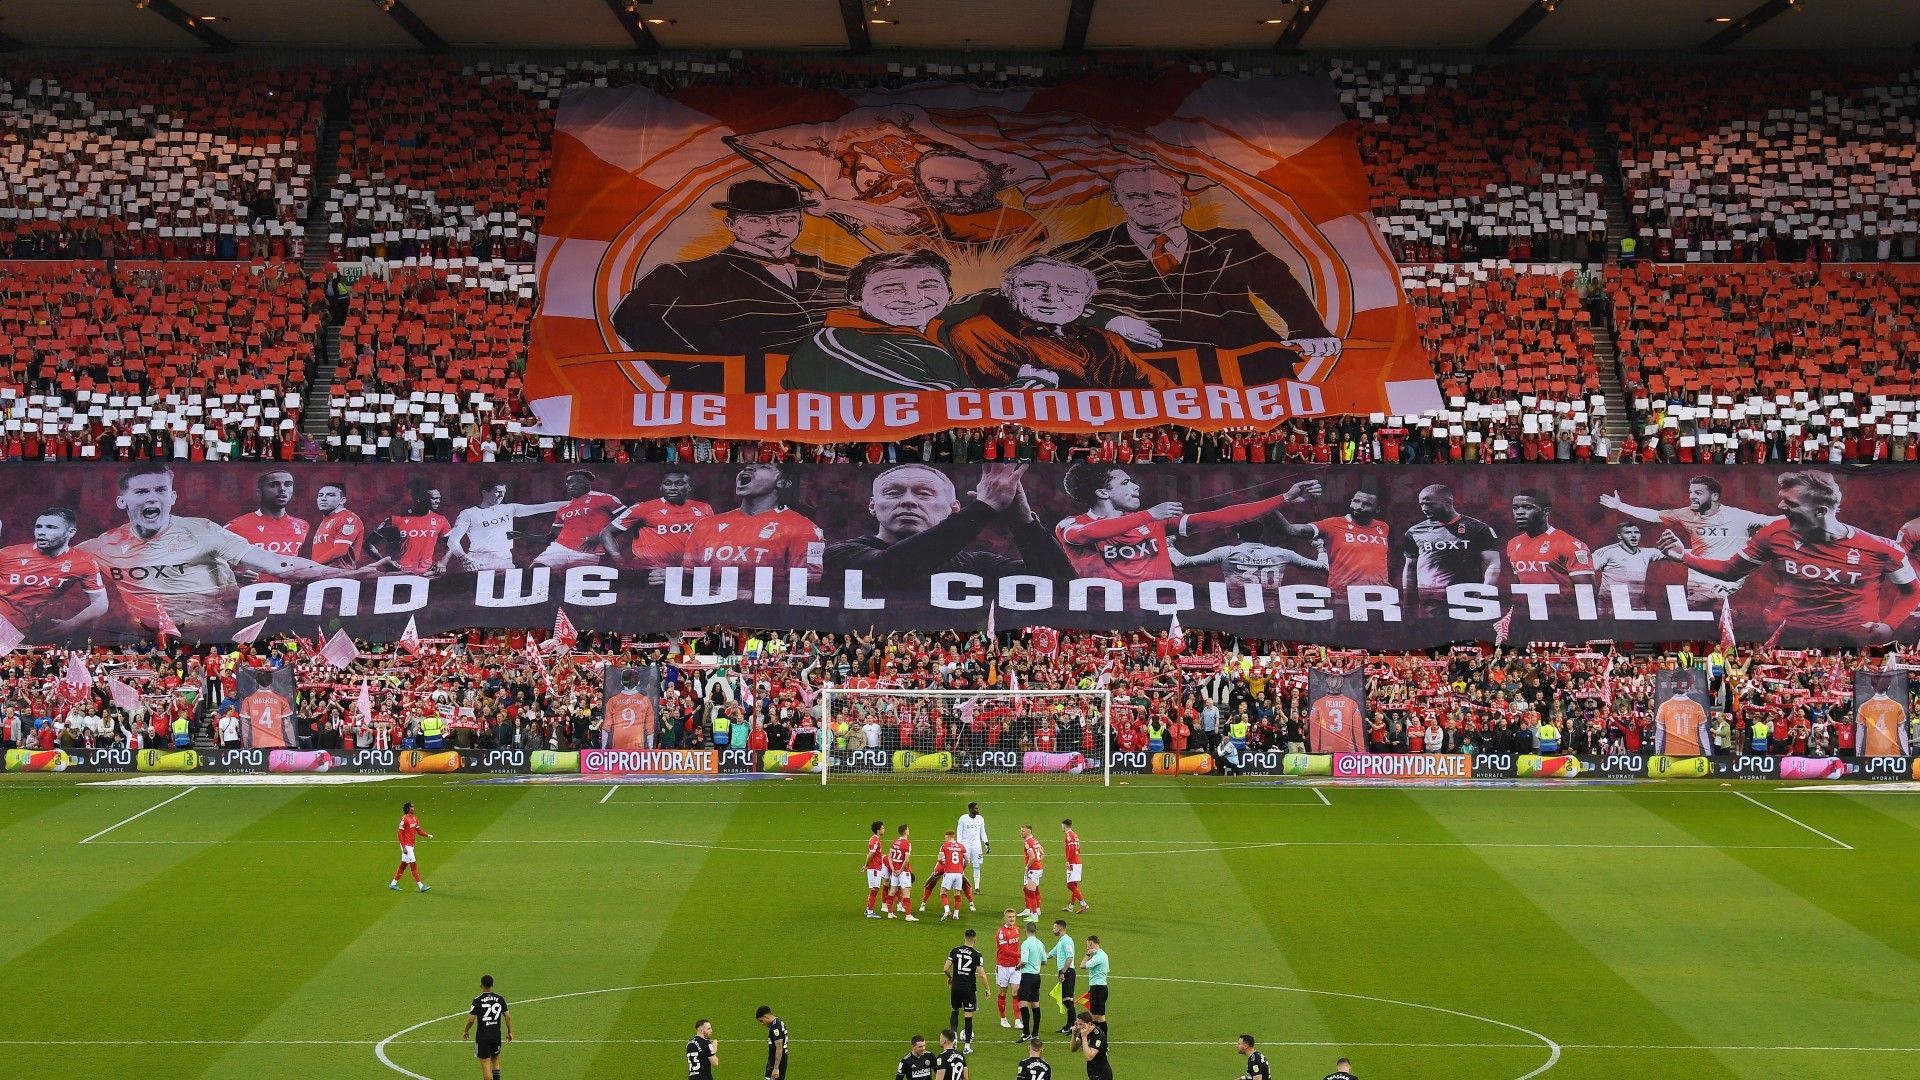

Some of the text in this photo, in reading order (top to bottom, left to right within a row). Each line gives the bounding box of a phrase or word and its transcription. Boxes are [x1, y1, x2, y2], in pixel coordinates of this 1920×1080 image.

[344, 267, 362, 275] EXIT
[632, 380, 1326, 431] WE HAVE CONQUERED
[481, 515, 511, 528] BOXT
[256, 541, 303, 553] BOXT
[1104, 538, 1159, 560] BOXT
[1345, 533, 1388, 546] BOXT
[1424, 540, 1471, 551] BOXT
[703, 545, 770, 563] BOXT
[9, 573, 69, 588] BOXT
[110, 563, 186, 581] BOXT
[1236, 565, 1280, 590] 30
[1785, 560, 1862, 585] BOXT
[235, 565, 1715, 622] AND WE WILL CONQUER STILL
[719, 656, 737, 665] EXIT
[259, 707, 273, 728] 4
[621, 708, 636, 729] 9
[1328, 709, 1343, 732] 3
[1675, 713, 1691, 735] 11
[586, 751, 713, 771] @iPROHYDRATE
[1338, 755, 1466, 775] @iPROHYDRATE
[891, 848, 903, 863] 22
[951, 851, 960, 864] 8
[956, 954, 973, 972] 12
[481, 1002, 502, 1021] 29
[950, 1061, 964, 1080] 19
